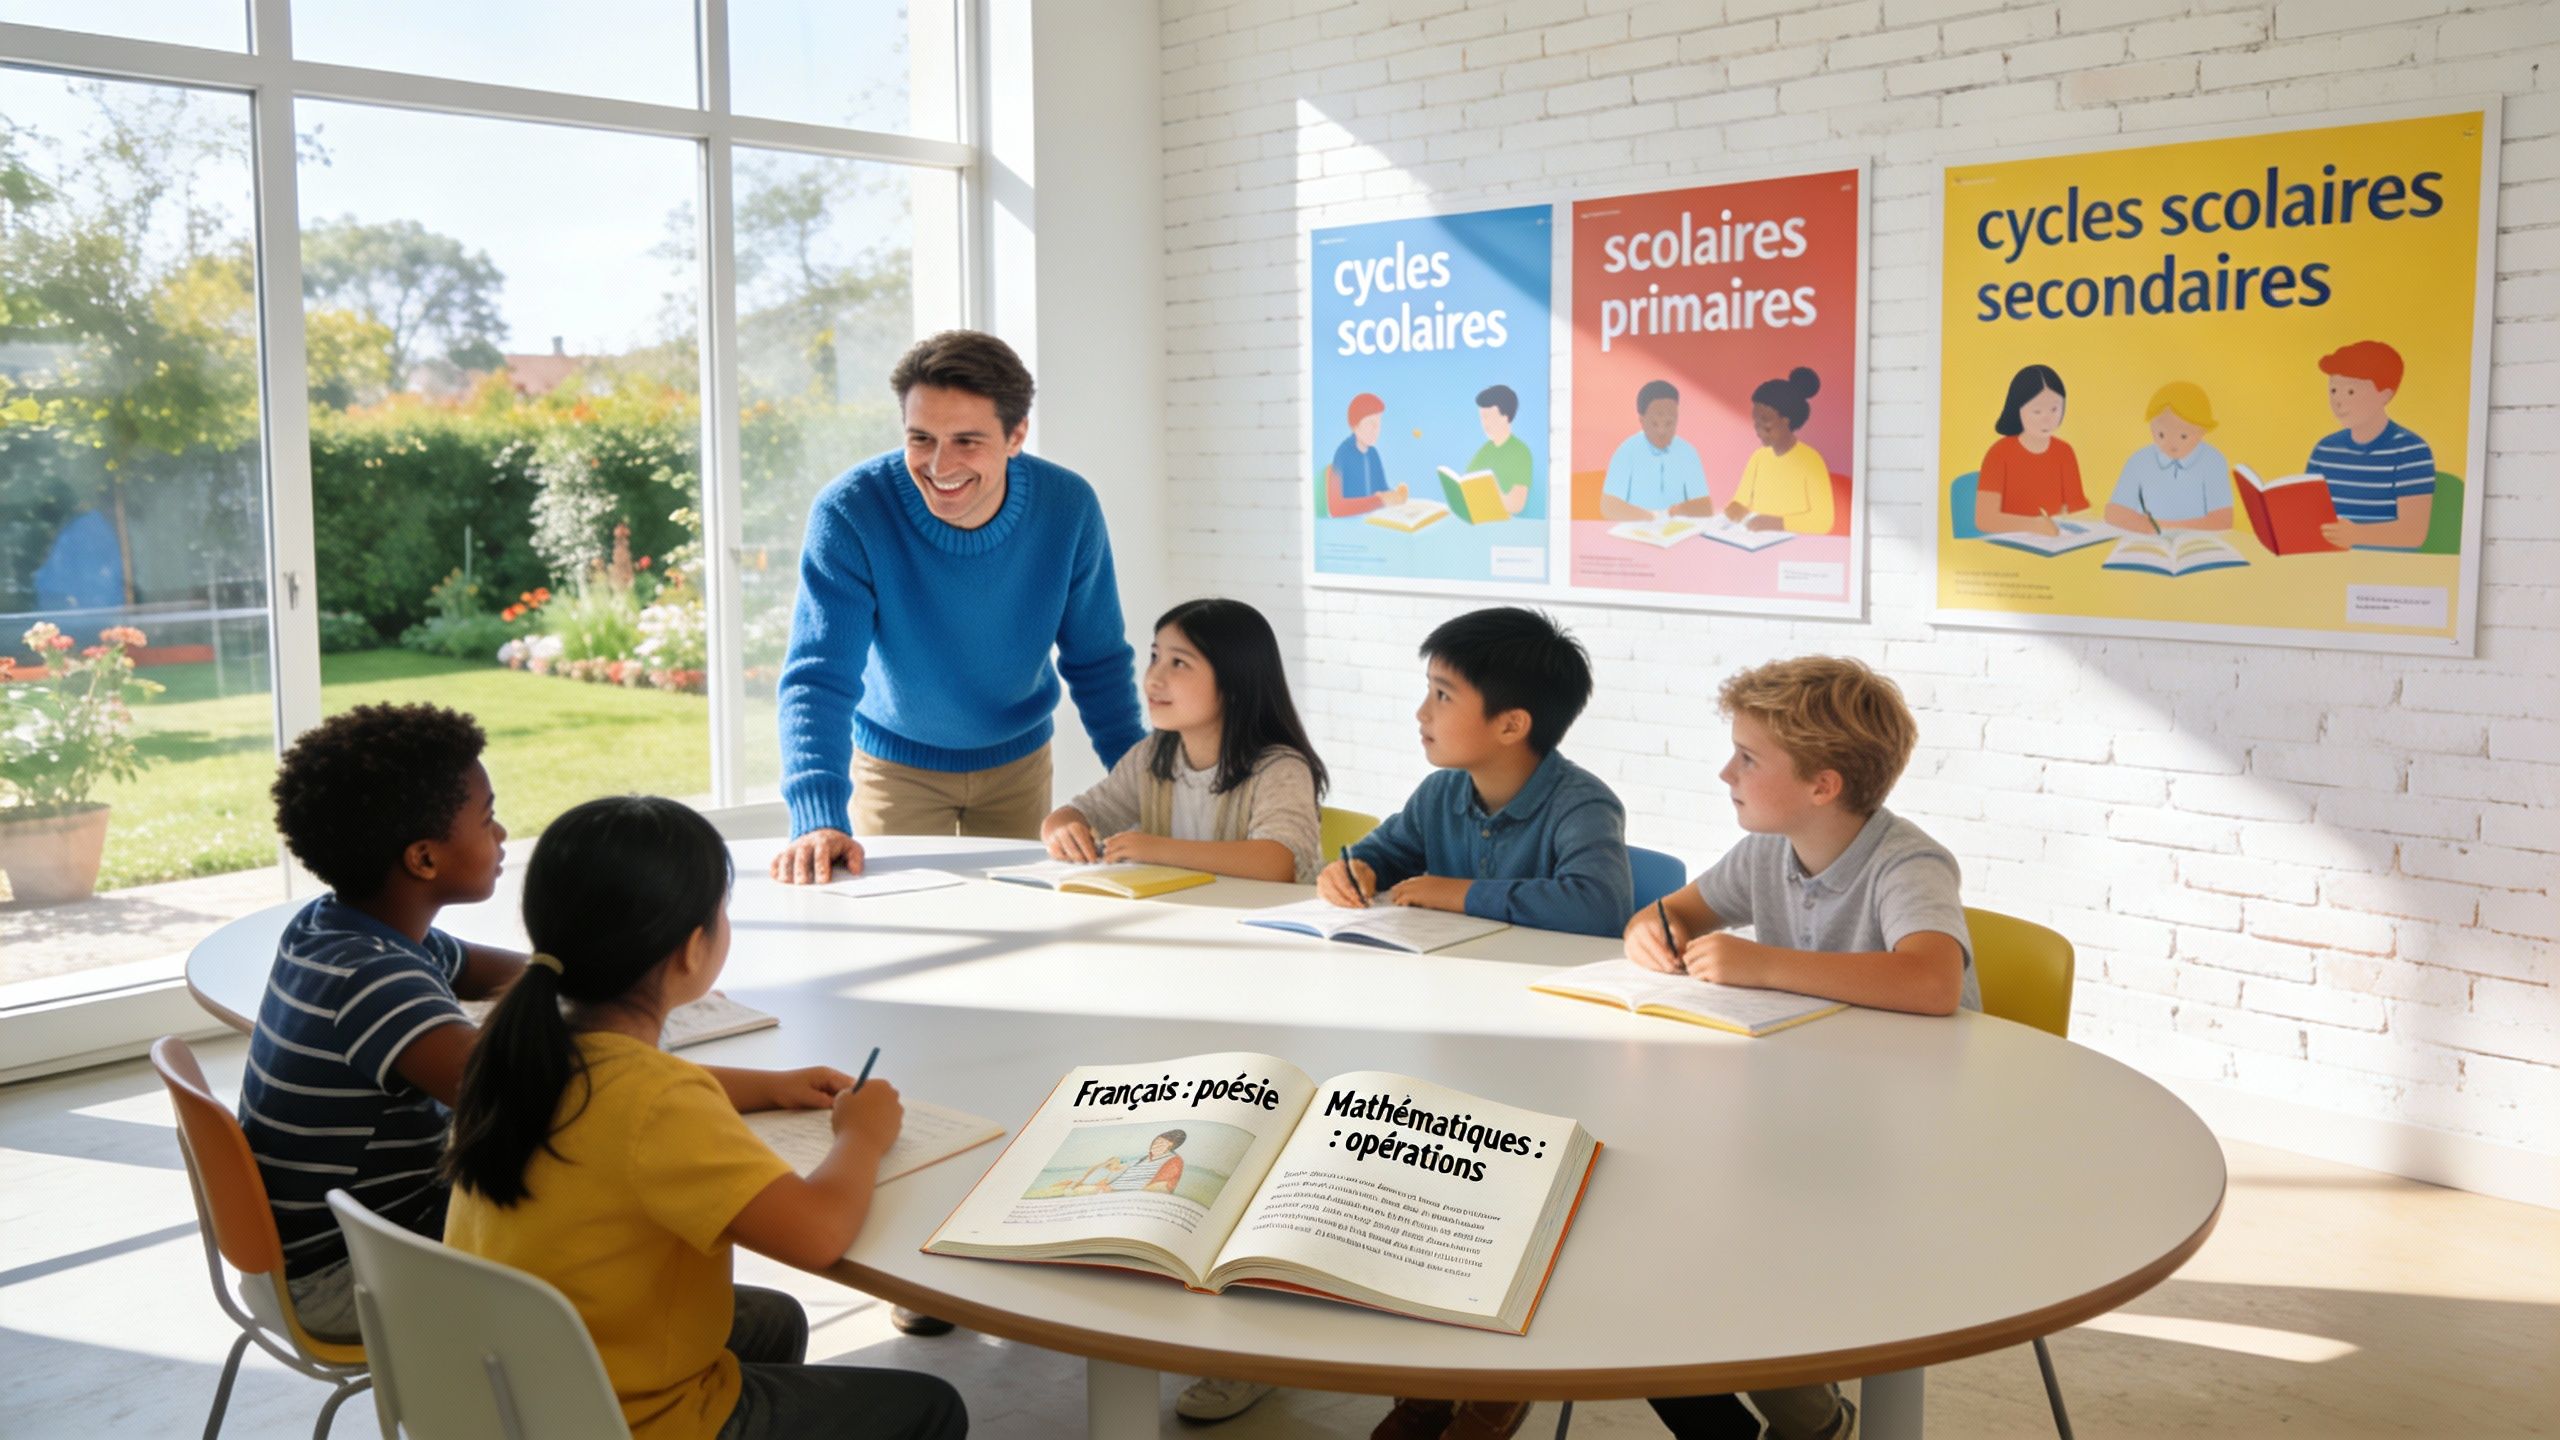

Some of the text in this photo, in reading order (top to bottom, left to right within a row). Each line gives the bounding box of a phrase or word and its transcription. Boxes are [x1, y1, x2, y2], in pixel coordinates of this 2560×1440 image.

[1604, 209, 1807, 273] scolaires
[1977, 163, 2444, 264] cycles scolaires
[1334, 240, 1451, 307] cycles
[1978, 252, 2331, 322] secondaires
[1337, 301, 1508, 356] scolaires
[1600, 276, 1818, 352] primaires
[1073, 1075, 1180, 1111] Français
[1191, 1073, 1279, 1111] poésie
[1324, 1090, 1532, 1156] Mathématiques
[1345, 1131, 1487, 1182] opérations
